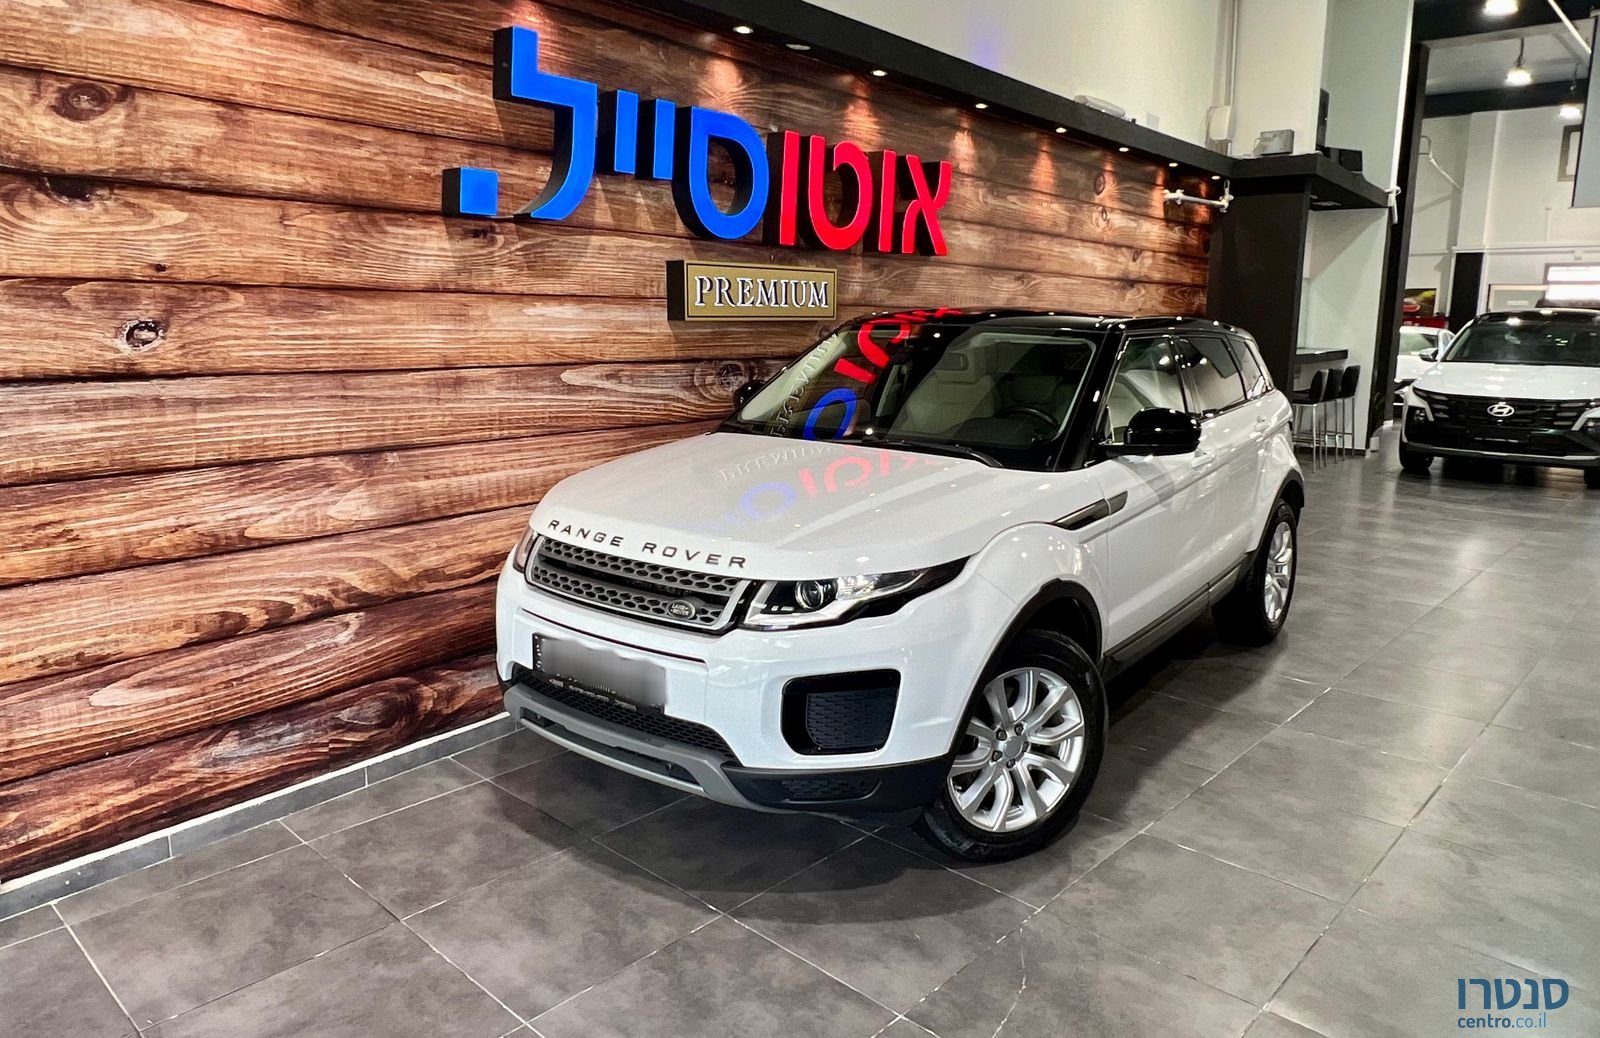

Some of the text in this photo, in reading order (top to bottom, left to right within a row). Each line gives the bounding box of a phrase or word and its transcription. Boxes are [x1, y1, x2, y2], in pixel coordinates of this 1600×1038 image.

[694, 275, 829, 308] PREMIUM
[548, 519, 747, 569] RANGE ROVER
